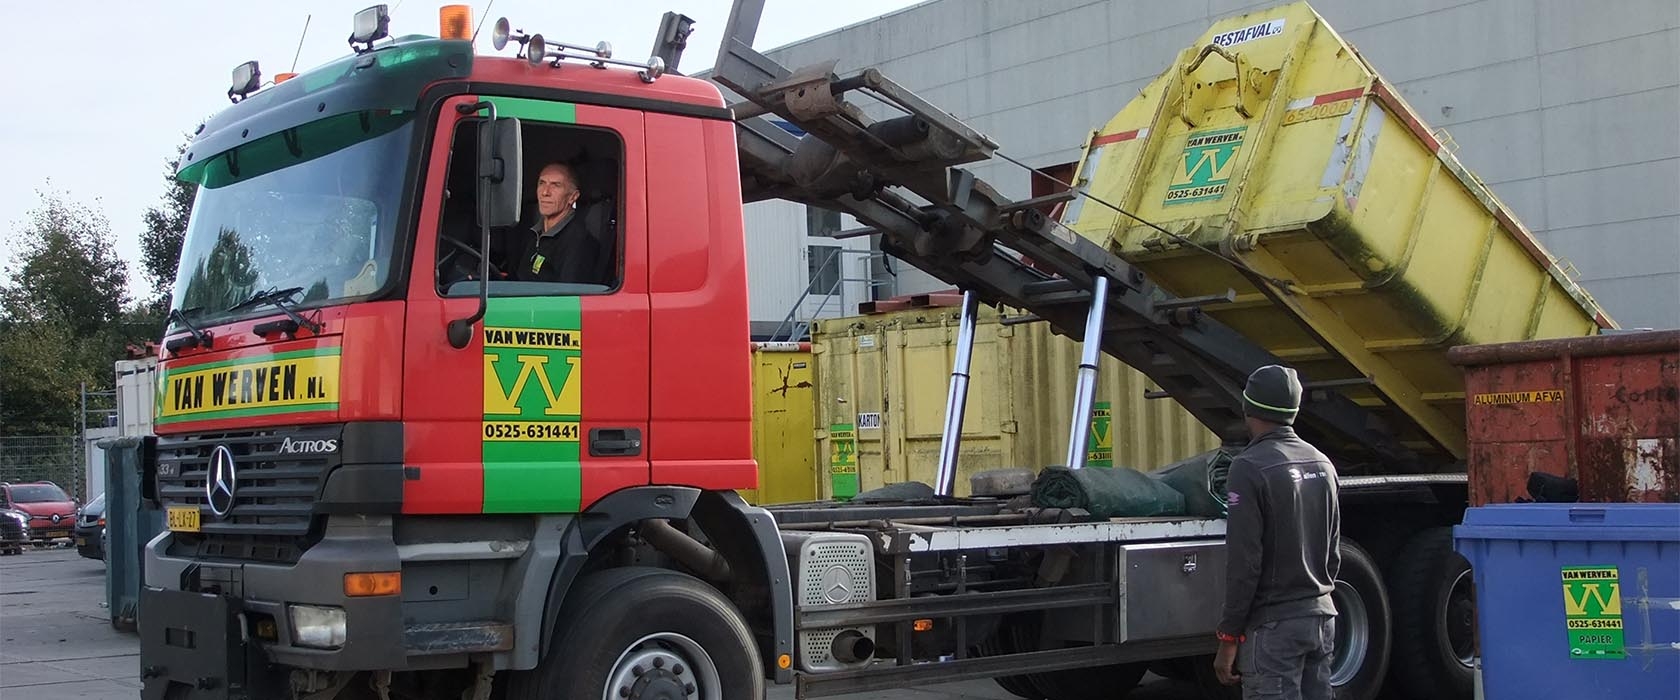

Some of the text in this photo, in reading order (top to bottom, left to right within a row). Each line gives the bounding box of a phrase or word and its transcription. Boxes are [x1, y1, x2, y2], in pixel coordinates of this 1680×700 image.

[1167, 185, 1225, 200] 0525-631441
[485, 329, 513, 344] VAN
[174, 375, 204, 411] VAN
[1475, 391, 1563, 405] ALUMINIUM AFVA
[484, 424, 578, 438] 0525-631441
[1562, 571, 1579, 579] VAN
[1568, 620, 1621, 628] 0525-631441
[1579, 635, 1612, 643] PAPIER
